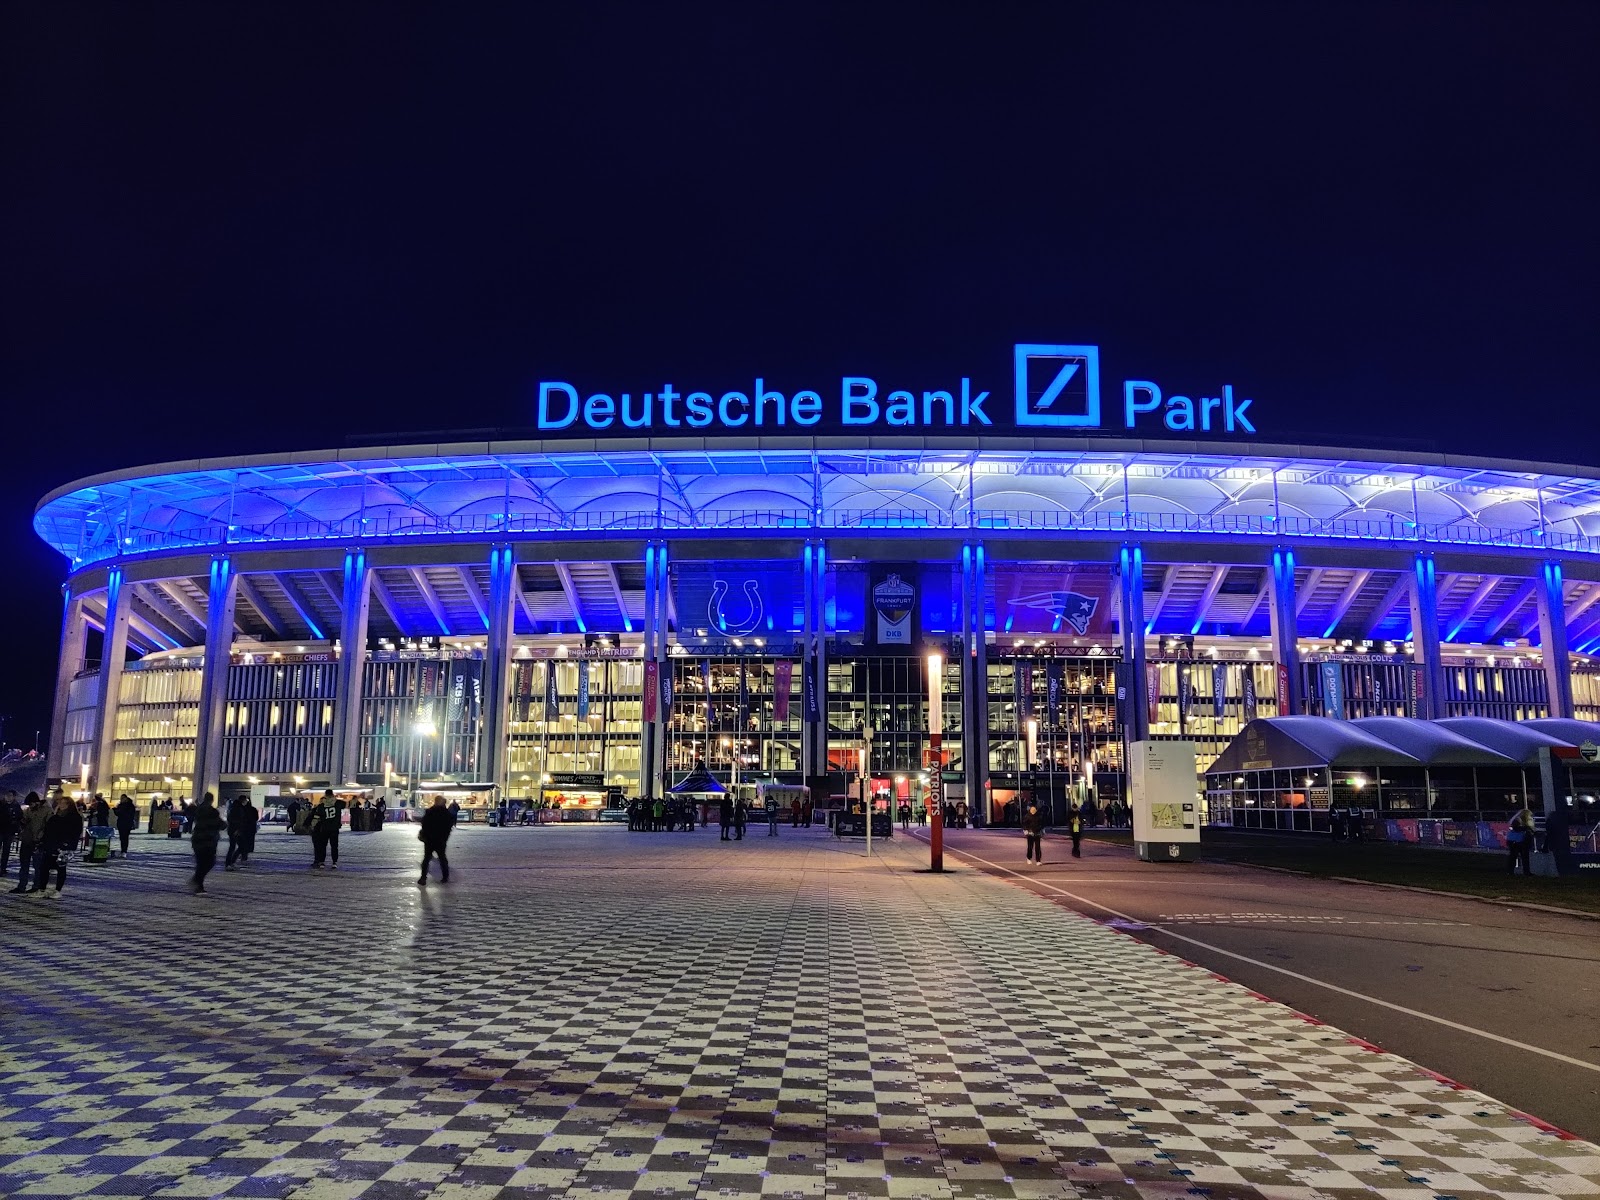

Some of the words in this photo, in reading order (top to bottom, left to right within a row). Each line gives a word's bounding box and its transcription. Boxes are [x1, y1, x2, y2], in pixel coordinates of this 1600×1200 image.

[536, 377, 823, 431] Deutsche
[840, 376, 993, 427] Bank
[1122, 379, 1257, 434] Park
[600, 648, 638, 656] PATRIOTS
[454, 675, 464, 697] DKB
[1050, 677, 1058, 710] DERTOUR
[930, 760, 940, 816] PATRIOTS
[324, 806, 336, 820] 12
